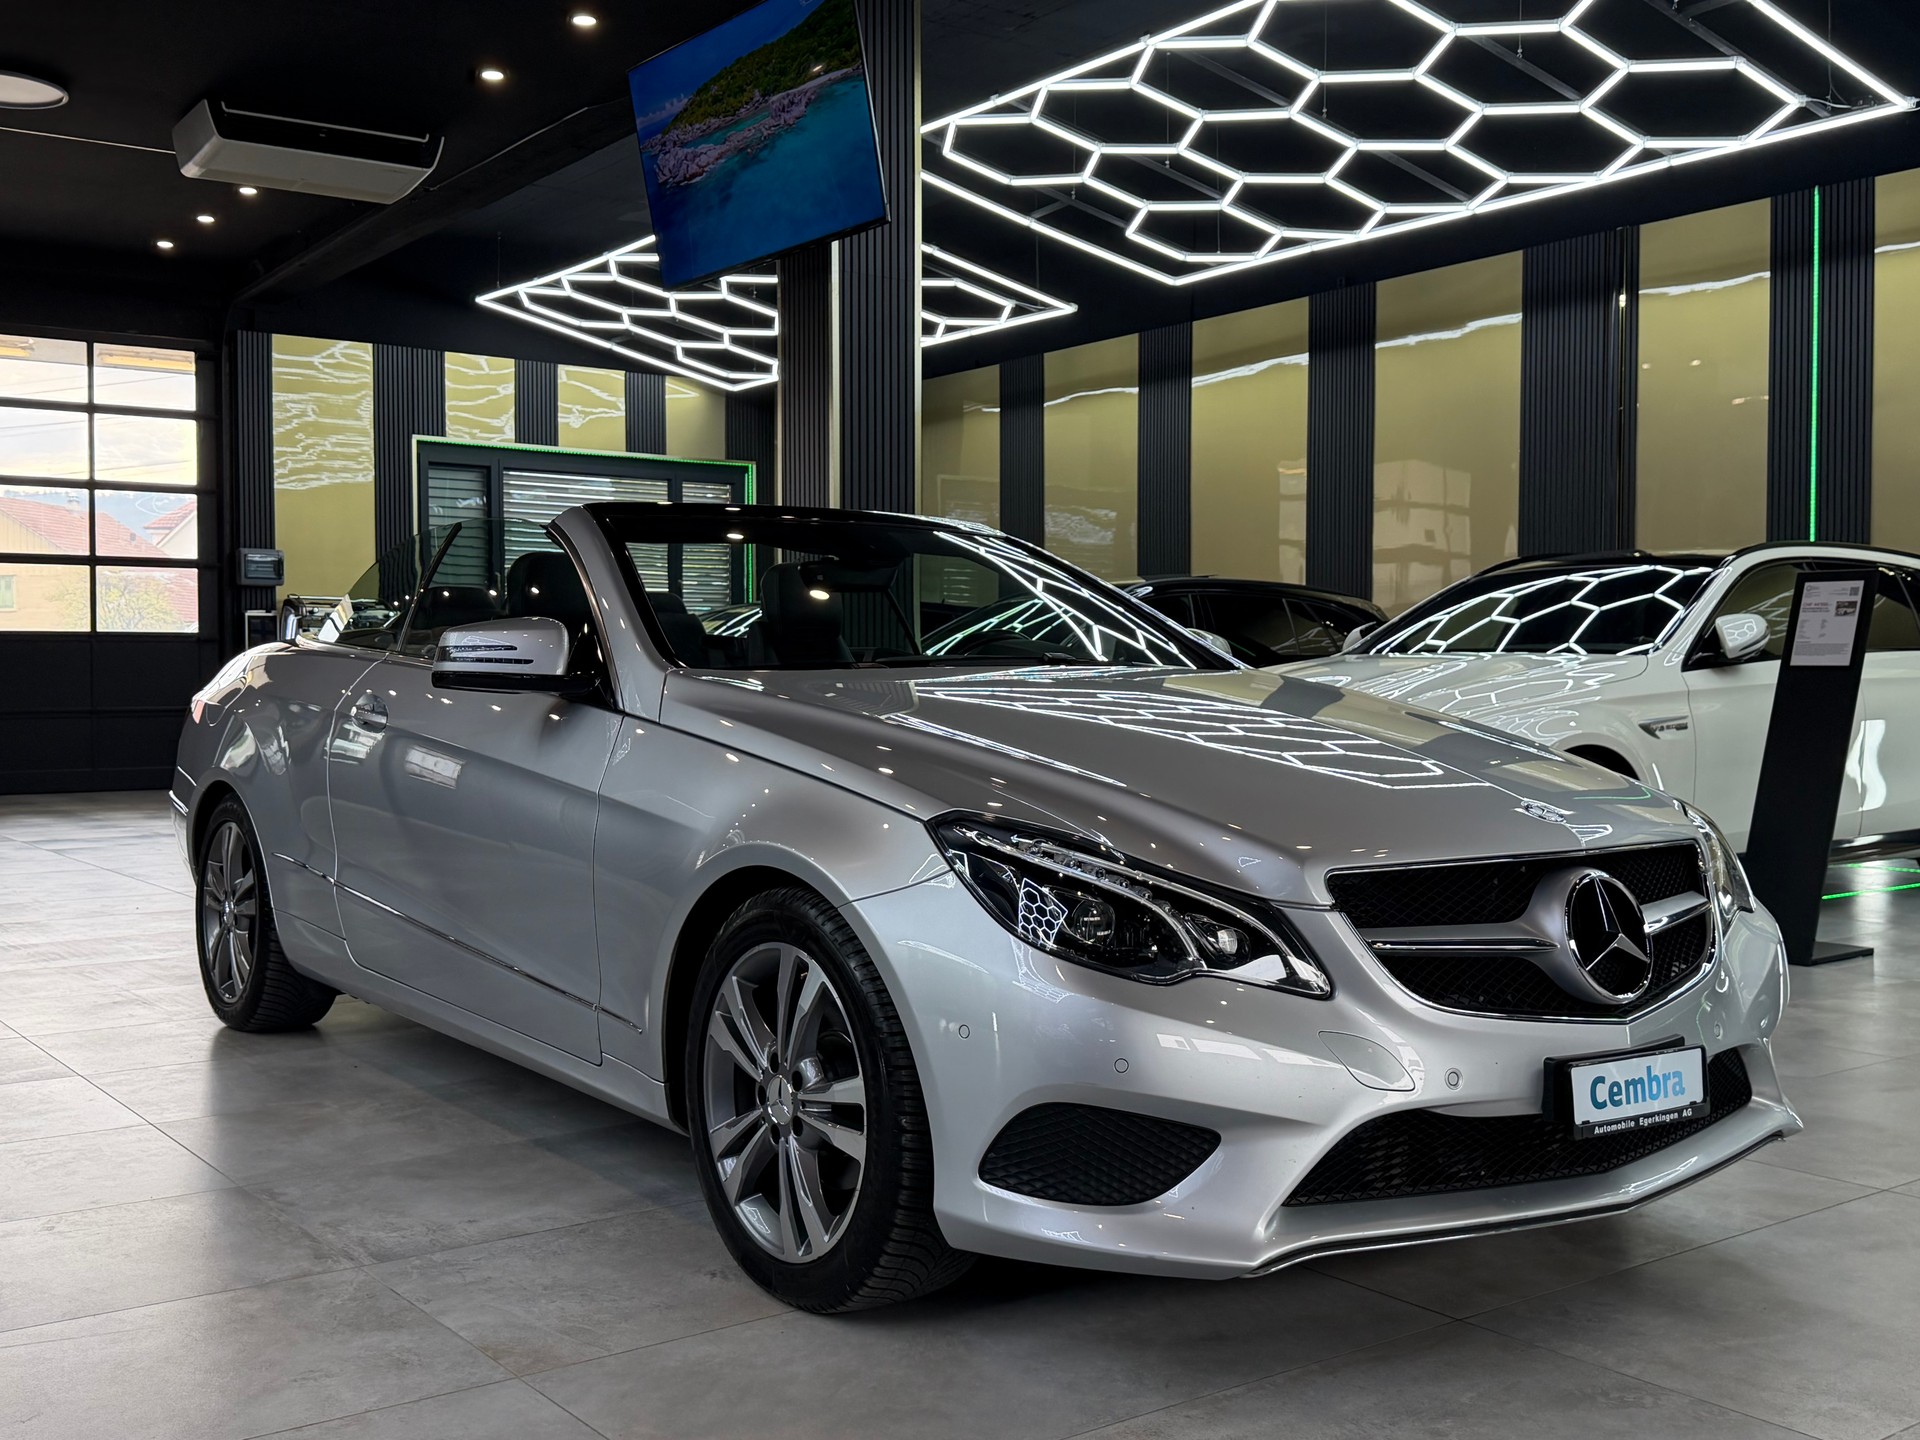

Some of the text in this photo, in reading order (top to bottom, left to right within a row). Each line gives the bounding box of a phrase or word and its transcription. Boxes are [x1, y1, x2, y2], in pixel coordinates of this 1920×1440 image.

[1590, 1065, 1686, 1110] Cembra
[1594, 1108, 1693, 1135] Automobile Egerkingen AG
